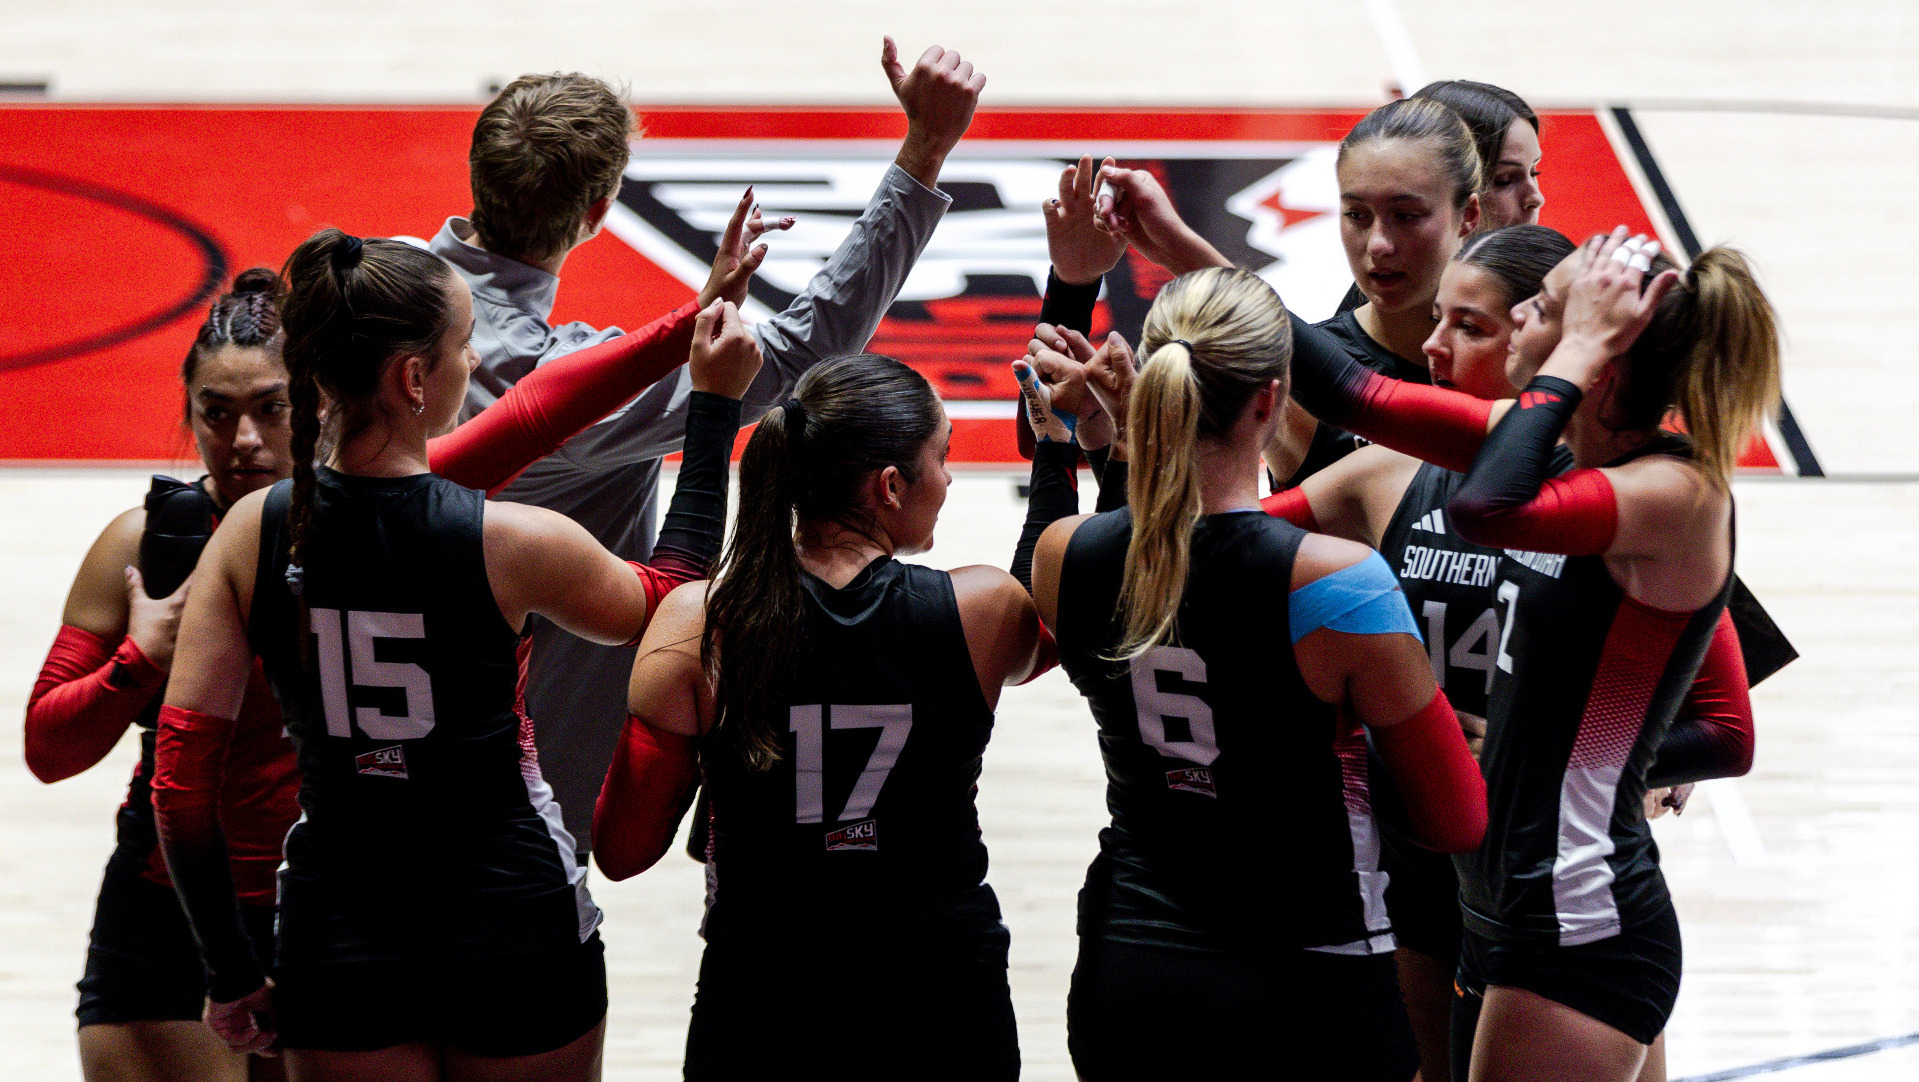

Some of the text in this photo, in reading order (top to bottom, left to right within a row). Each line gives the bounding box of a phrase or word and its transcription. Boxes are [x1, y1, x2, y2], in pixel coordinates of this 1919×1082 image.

[1400, 545, 1503, 587] SOUTHERN
[309, 607, 436, 740] 15
[1422, 600, 1501, 695] 14
[1129, 645, 1221, 766] 6
[375, 748, 402, 764] SKY
[789, 703, 913, 824] 17
[1185, 769, 1211, 784] SKY
[846, 823, 873, 839] SKY
